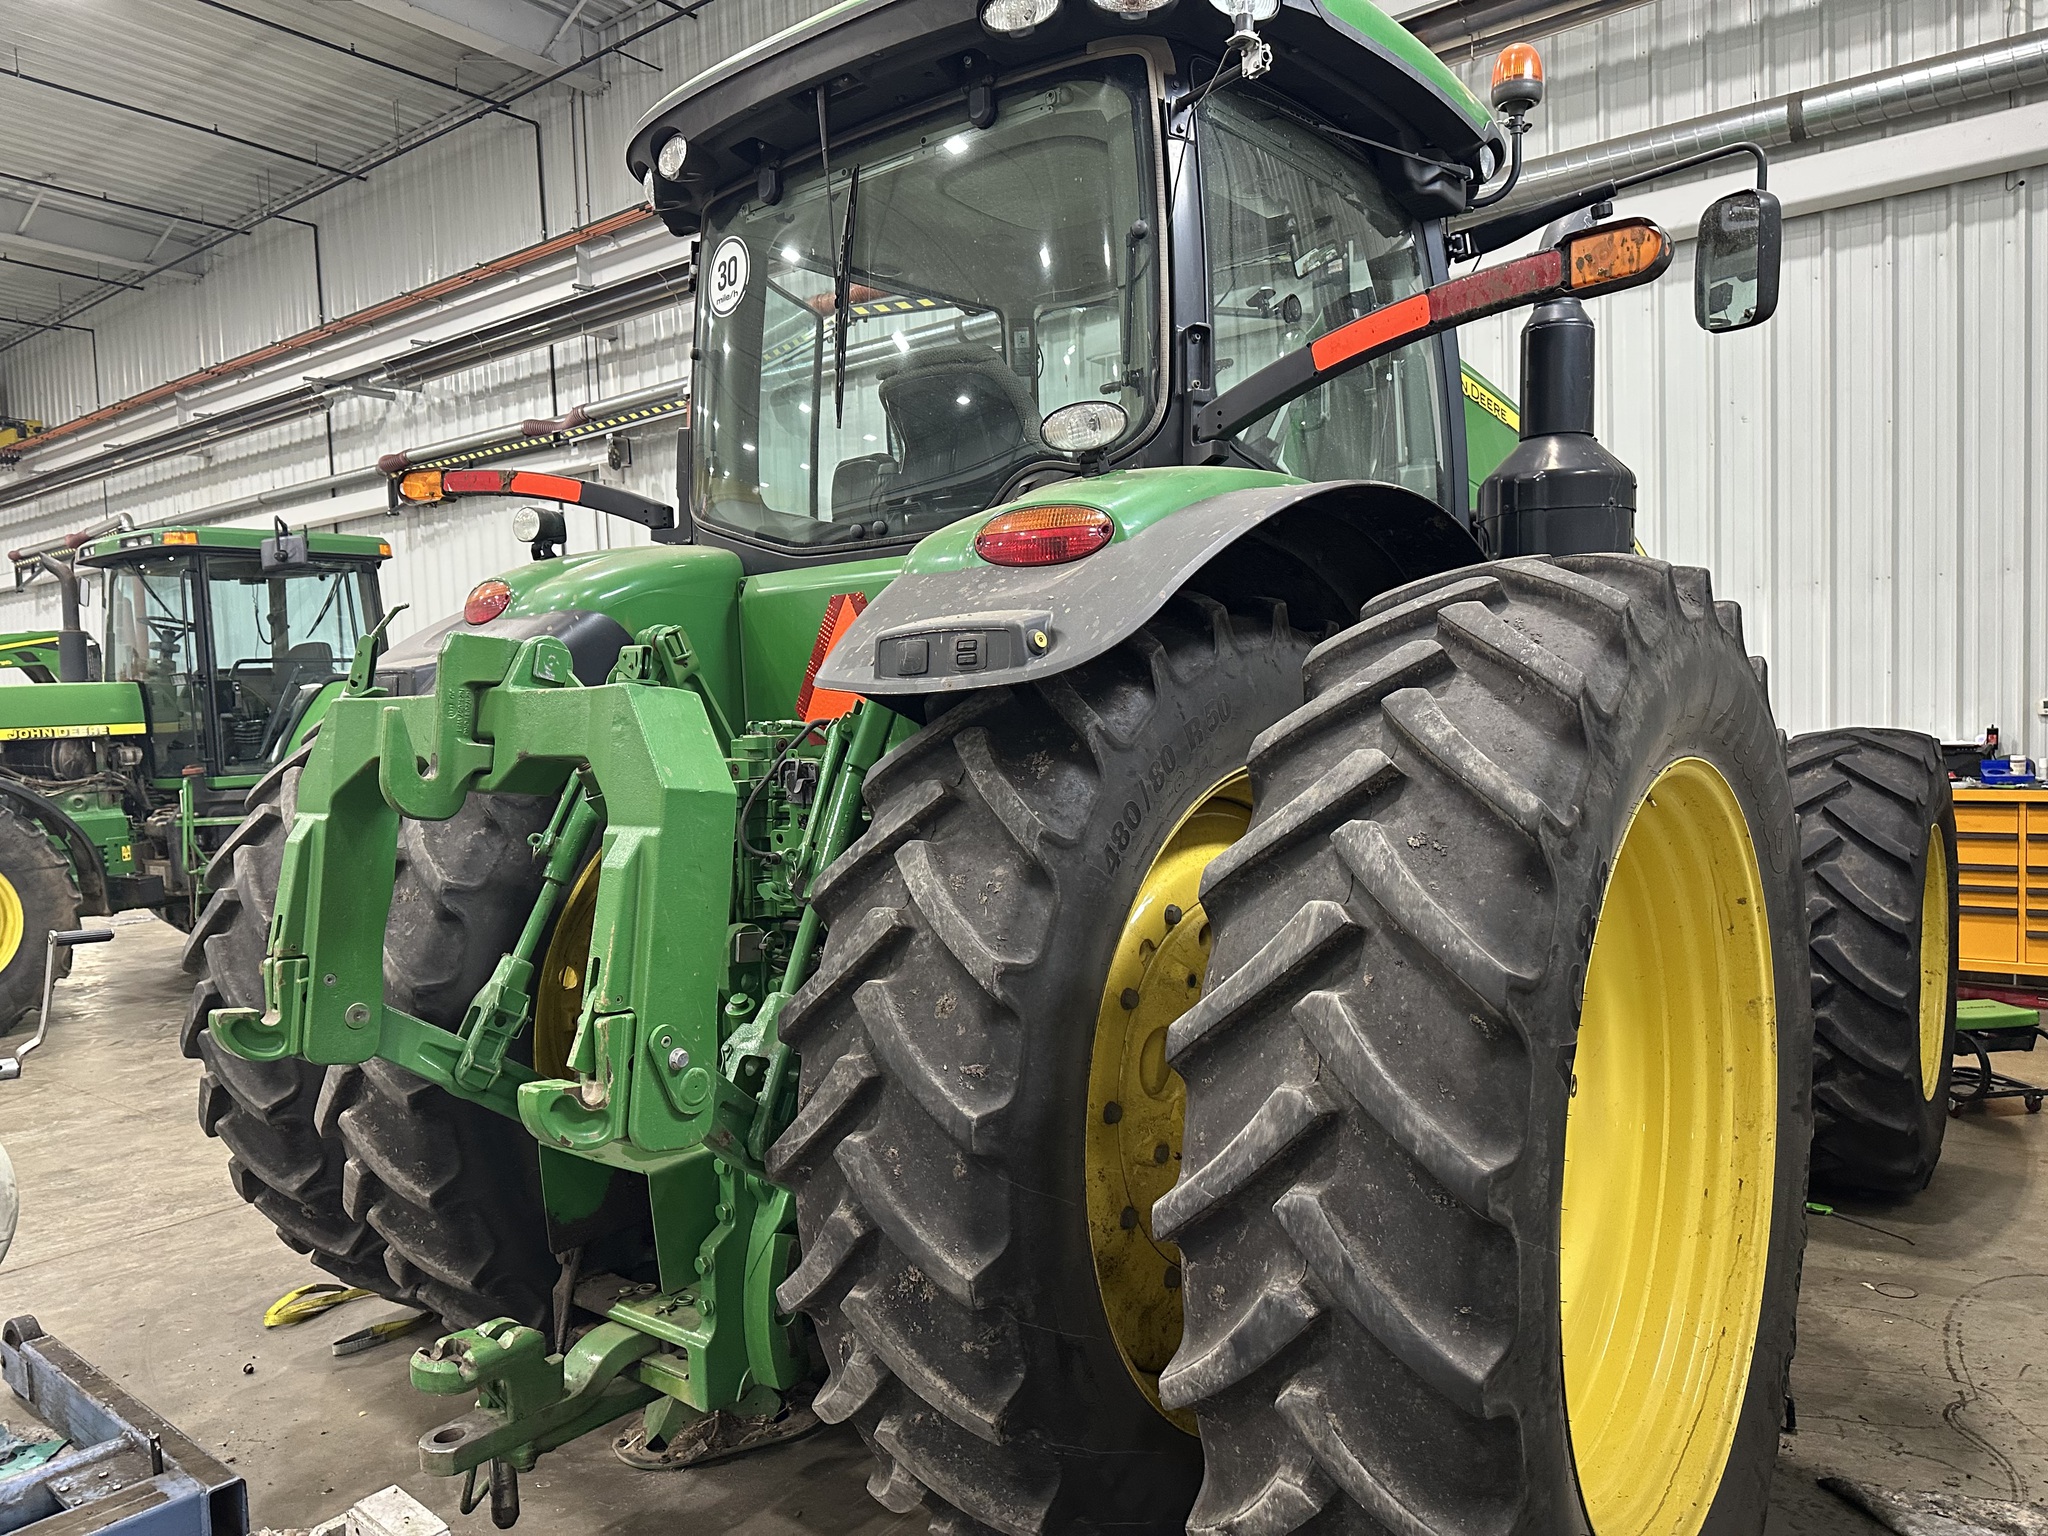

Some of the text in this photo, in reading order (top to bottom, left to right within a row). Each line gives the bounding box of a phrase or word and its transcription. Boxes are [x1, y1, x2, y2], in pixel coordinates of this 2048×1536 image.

[717, 255, 738, 291] 30
[1470, 382, 1508, 422] DEERE
[8, 725, 110, 740] JOHN DEERE
[1103, 743, 1176, 877] 480/80
